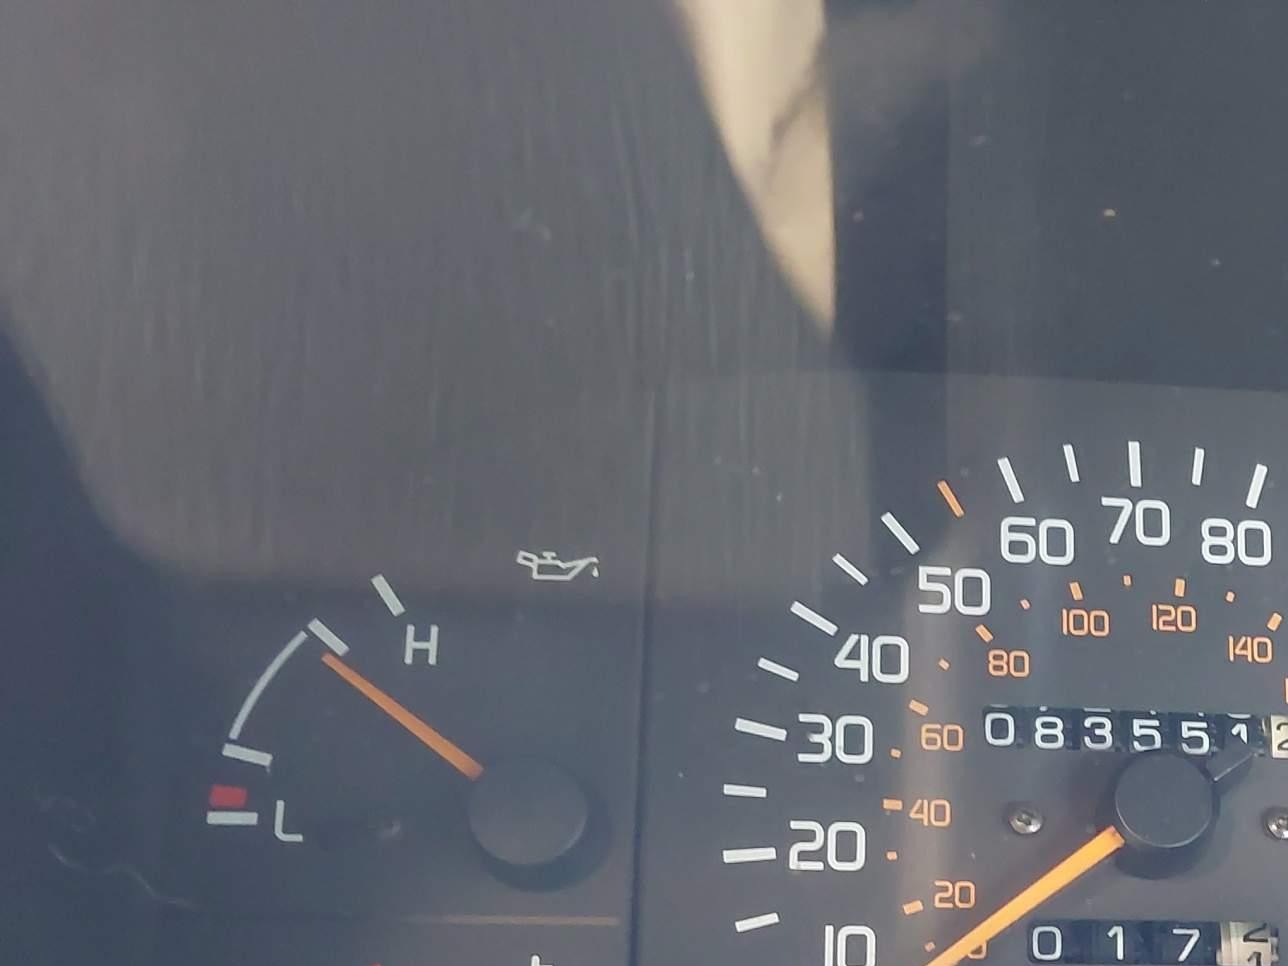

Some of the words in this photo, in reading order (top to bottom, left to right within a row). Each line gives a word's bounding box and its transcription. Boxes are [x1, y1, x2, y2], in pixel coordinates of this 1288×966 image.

[1000, 516, 1075, 566] 60
[1101, 496, 1171, 546] 70
[1201, 518, 1272, 566] 80
[918, 565, 991, 616] 50
[1062, 608, 1110, 637] 100
[1151, 604, 1197, 632] 120
[404, 624, 439, 665] H
[834, 633, 910, 684] 40
[988, 649, 1030, 677] 80
[1228, 635, 1273, 663] 140
[797, 713, 874, 764] 30
[920, 723, 964, 752] 60
[274, 799, 304, 842] L
[909, 799, 951, 827] 40
[788, 820, 866, 871] 20
[933, 880, 976, 909] 20
